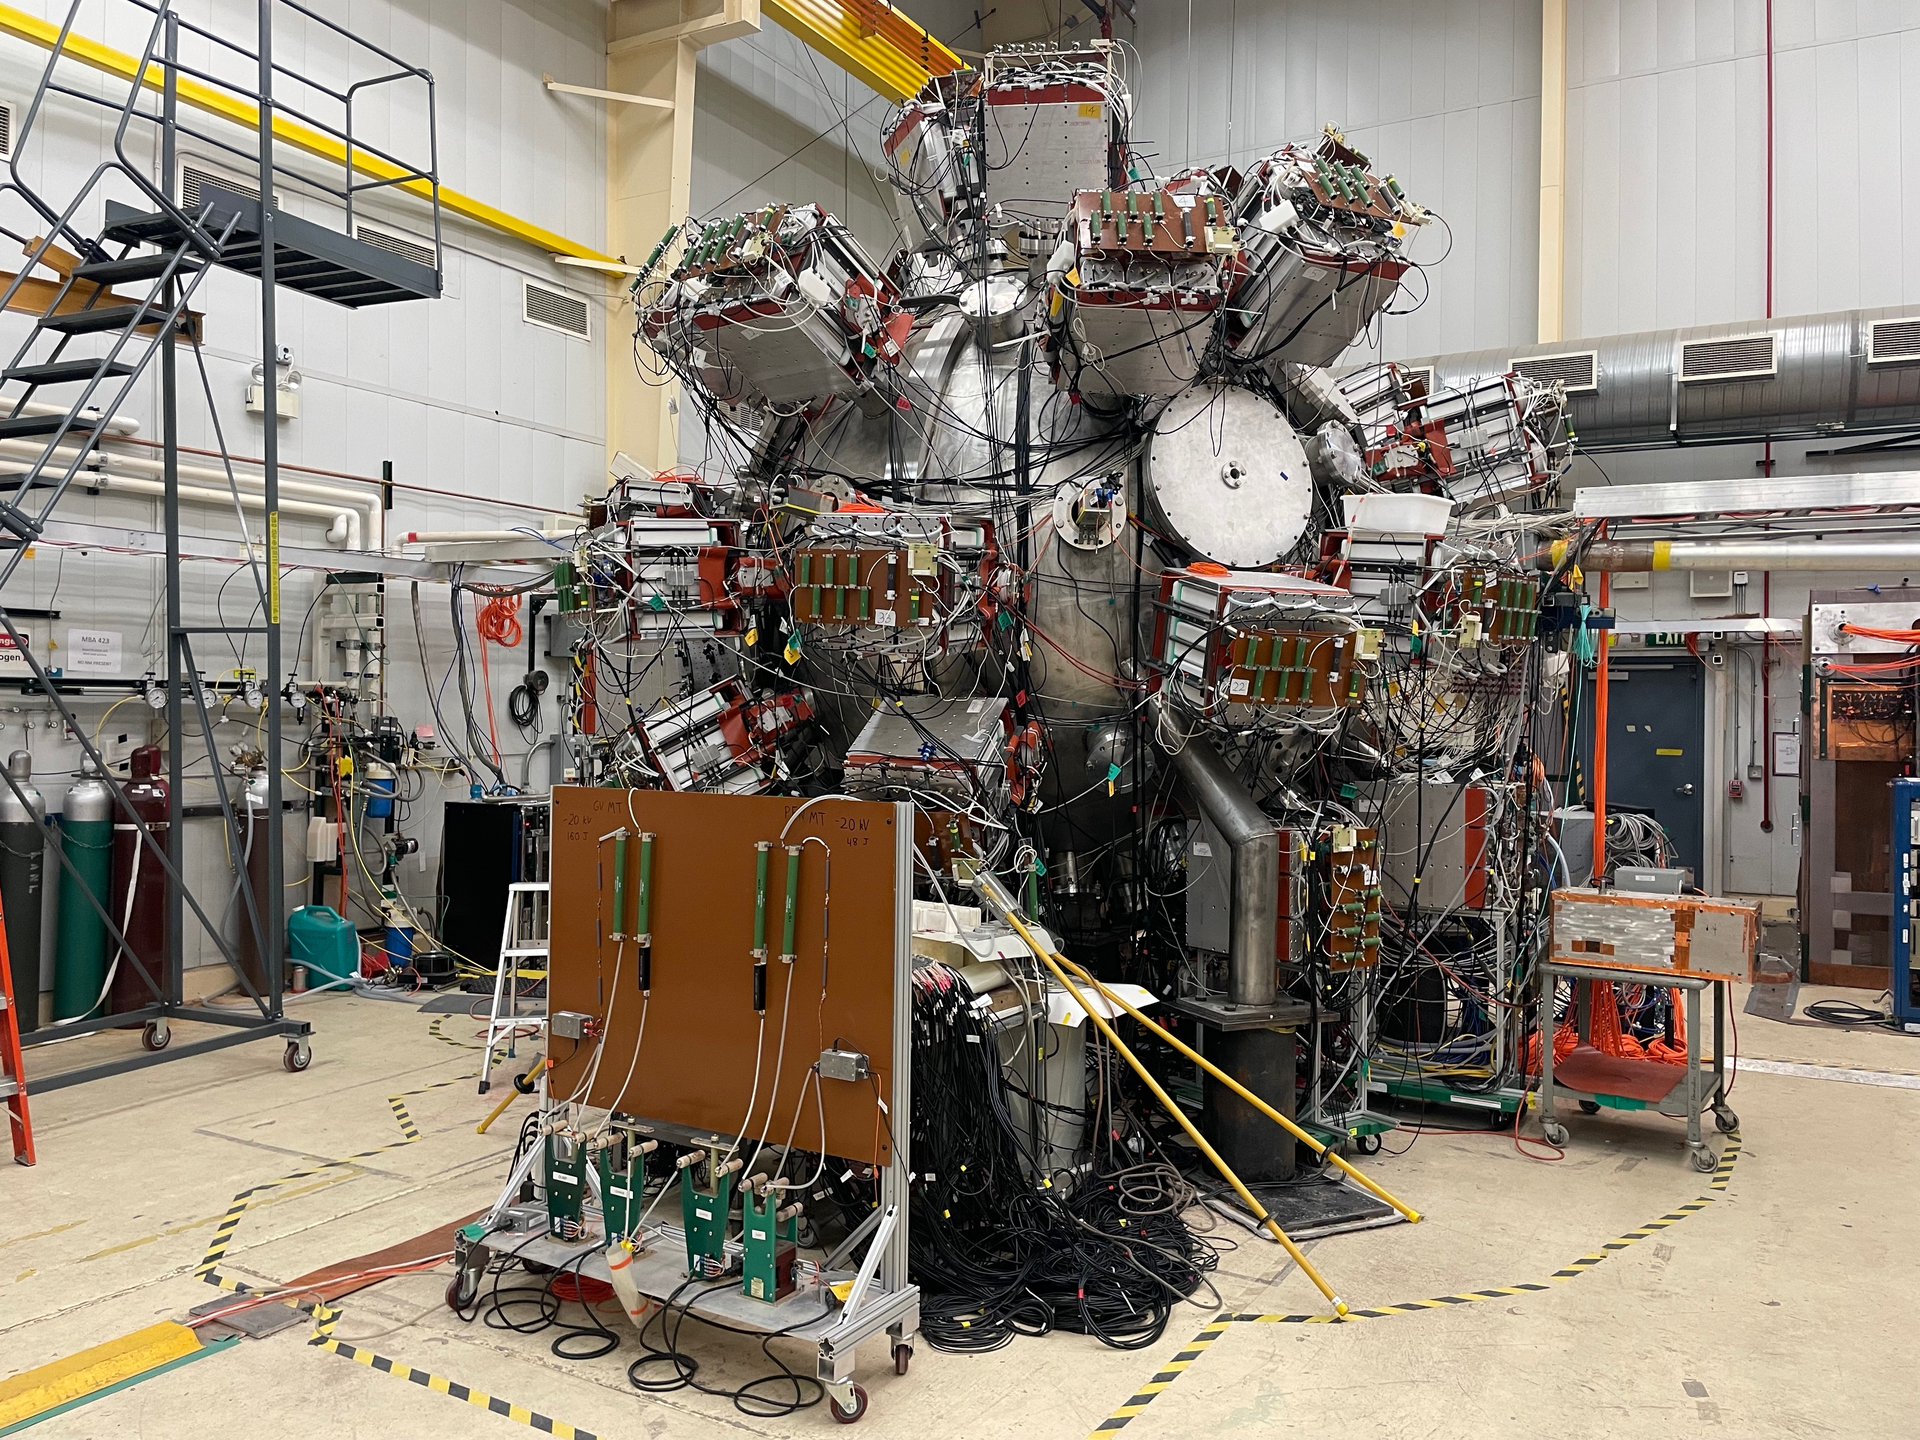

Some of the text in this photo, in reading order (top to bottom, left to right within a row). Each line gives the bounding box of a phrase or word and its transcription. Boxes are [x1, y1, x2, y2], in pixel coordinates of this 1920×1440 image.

[1084, 105, 1096, 117] 14
[1178, 196, 1189, 206] 4
[1308, 268, 1322, 278] 5
[97, 637, 110, 645] 423
[1232, 681, 1246, 692] 22
[608, 801, 622, 814] MT
[809, 811, 825, 826] MT
[835, 816, 870, 831] -20 kV
[846, 837, 870, 847] 48 J
